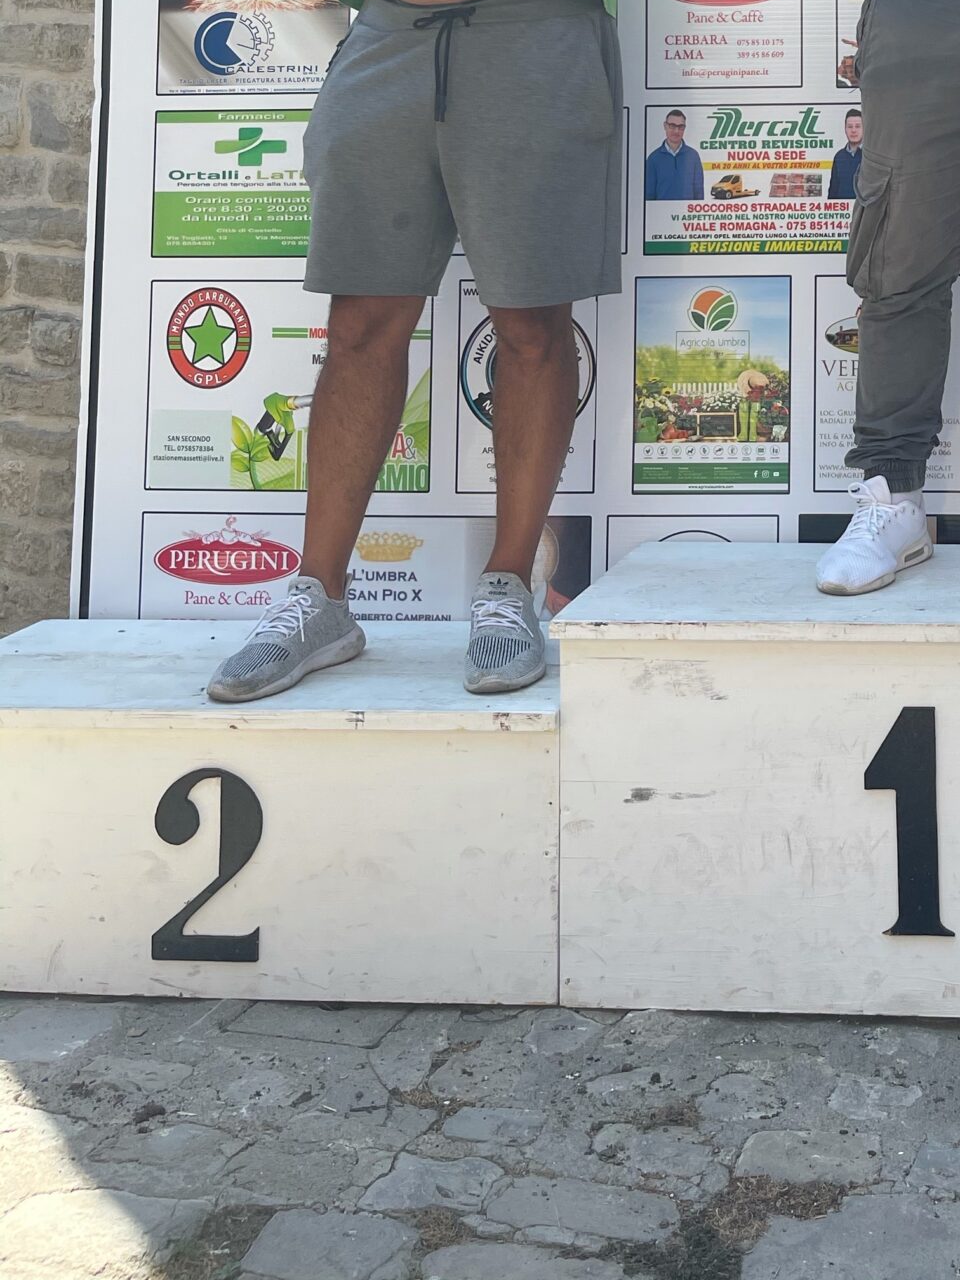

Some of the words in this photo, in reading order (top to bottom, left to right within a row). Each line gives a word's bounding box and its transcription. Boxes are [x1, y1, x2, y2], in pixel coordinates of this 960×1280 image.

[687, 11, 713, 24] Pane
[716, 11, 728, 23] &
[731, 10, 764, 23] Caffè
[664, 35, 728, 45] CERBARA
[664, 50, 704, 60] LAMA
[225, 65, 318, 74] CALESTRINI
[707, 107, 825, 139] Mercati
[700, 140, 757, 150] CENTRO
[761, 139, 833, 149] REVISIONI
[727, 151, 770, 161] NUOVA
[774, 150, 806, 160] SEDE
[168, 170, 239, 180] Ortalli
[185, 196, 231, 204] Orario
[687, 203, 748, 213] SOCCORSO
[750, 203, 807, 212] STRADALE
[809, 202, 822, 211] 24
[182, 214, 199, 222] da
[683, 222, 716, 231] VIALE
[719, 222, 777, 231] ROMAGNA
[786, 221, 807, 231] 075
[690, 241, 760, 253] REVISIONE
[765, 240, 842, 252] IMMEDIATA
[172, 298, 194, 333] MONDO
[199, 292, 248, 335] CARBURANTI
[680, 336, 716, 350] Agricola
[169, 550, 290, 576] PERUGINI
[185, 591, 215, 605] Pane
[218, 592, 231, 605] &
[234, 590, 271, 606] Caffè
[411, 589, 422, 601] X
[863, 706, 956, 938] 1
[151, 767, 263, 963] 2
